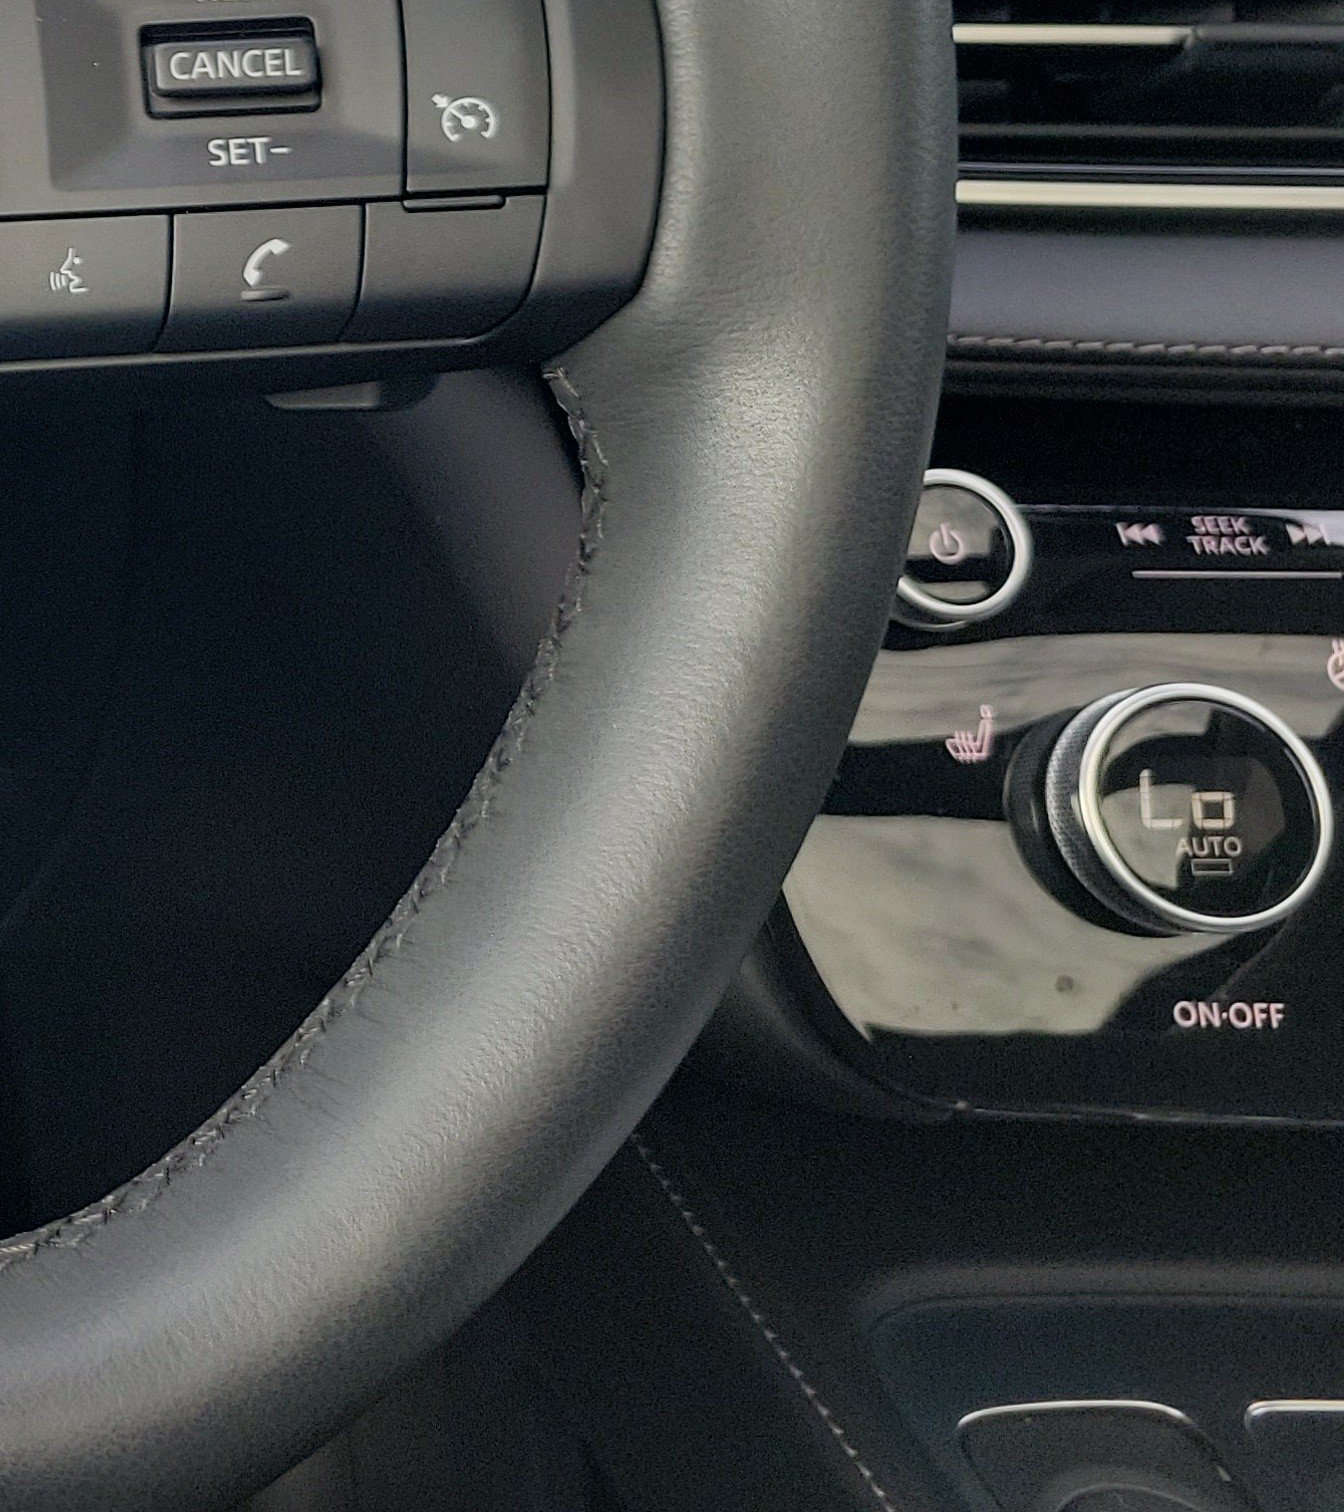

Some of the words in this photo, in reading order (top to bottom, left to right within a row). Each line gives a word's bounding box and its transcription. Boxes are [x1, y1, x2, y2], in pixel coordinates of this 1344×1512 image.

[169, 48, 303, 81] CANCEL
[1190, 515, 1252, 535] SEEK
[1186, 535, 1269, 556] TRACK
[1175, 836, 1242, 858] AUTO
